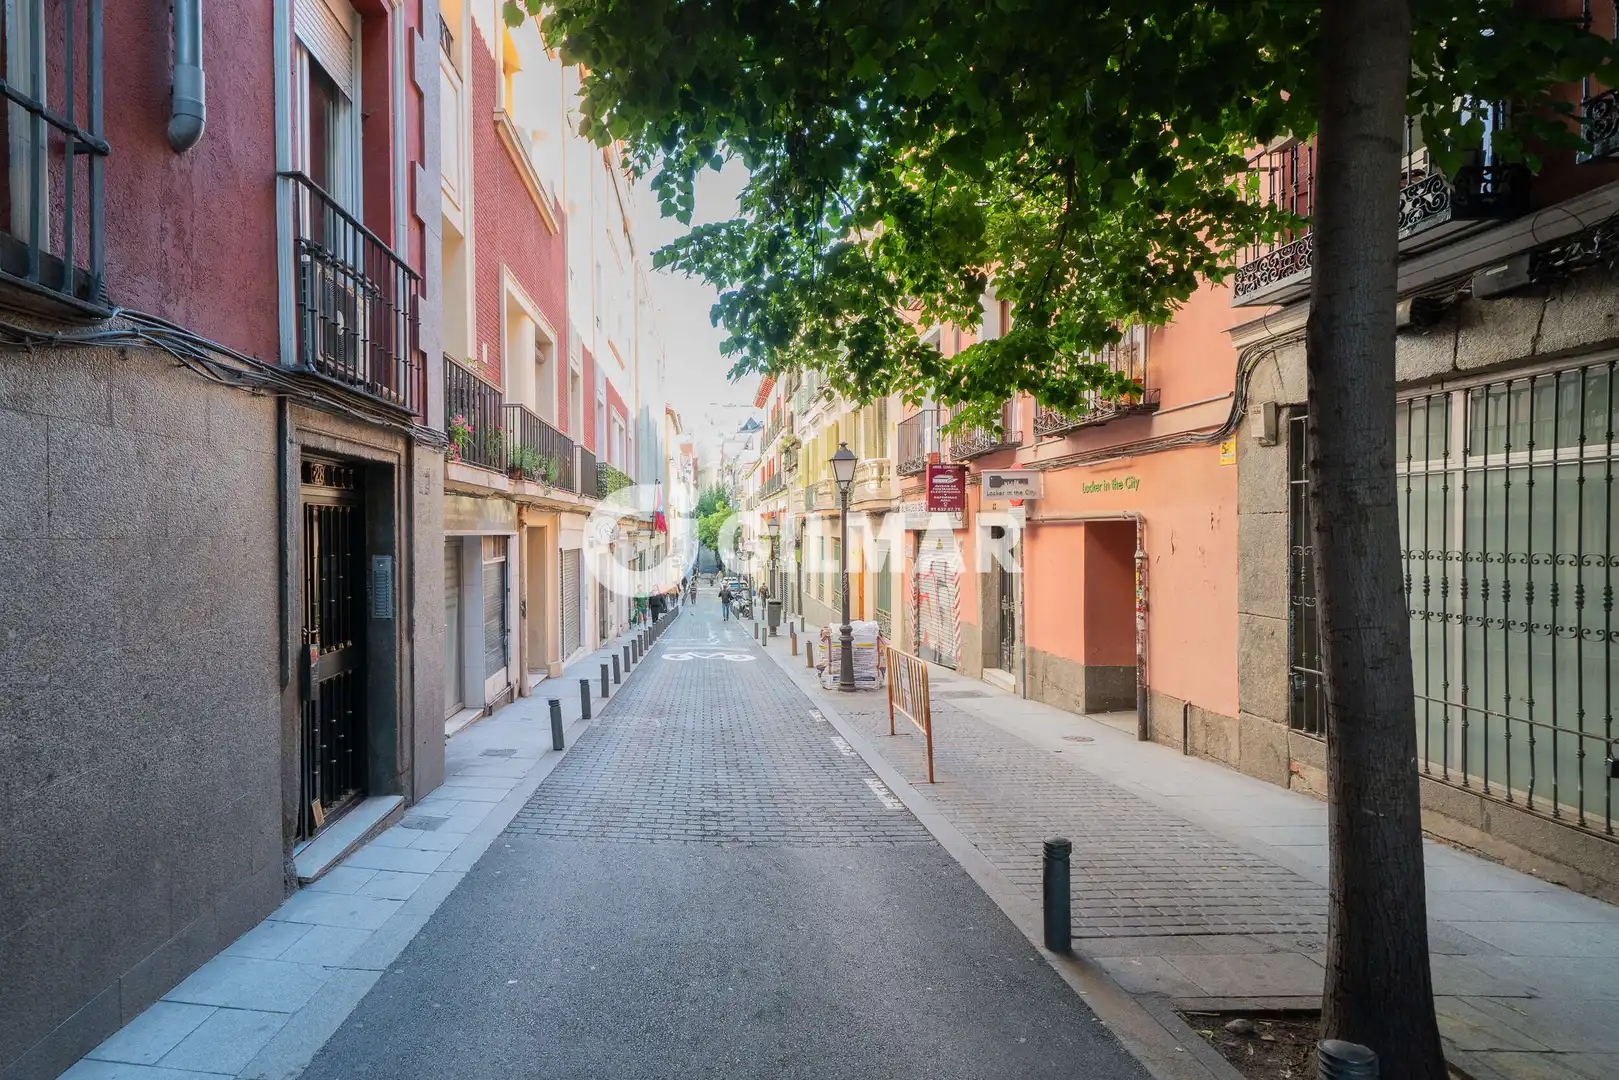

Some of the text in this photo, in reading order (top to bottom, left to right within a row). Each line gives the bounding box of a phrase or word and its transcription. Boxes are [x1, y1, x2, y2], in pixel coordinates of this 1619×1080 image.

[314, 466, 324, 483] 28
[1025, 488, 1037, 496] City
[1082, 476, 1140, 494] Locker in the City
